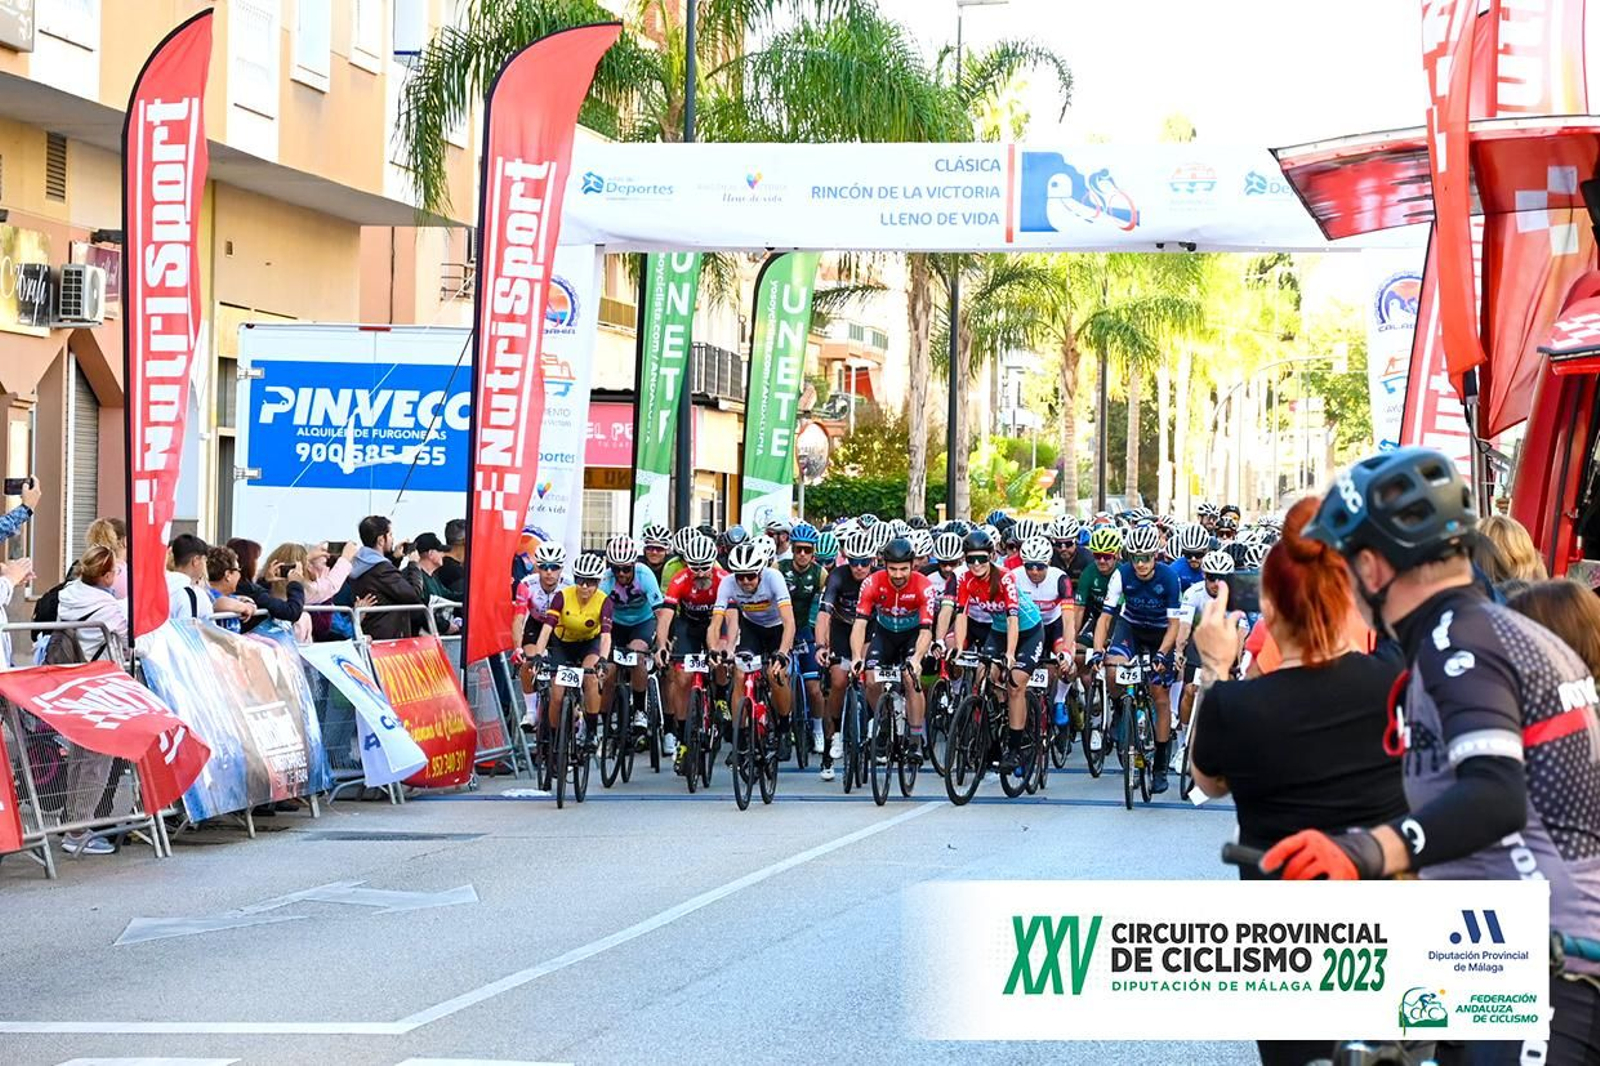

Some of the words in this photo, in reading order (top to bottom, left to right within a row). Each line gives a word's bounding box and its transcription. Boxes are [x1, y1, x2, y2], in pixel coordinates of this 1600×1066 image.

[934, 156, 1001, 172] CLÁSICA
[606, 181, 674, 197] Deportes
[811, 182, 873, 199] RINCÓN
[878, 186, 899, 199] DE
[902, 186, 923, 199] LA
[927, 185, 1001, 199] VICTORIA
[880, 212, 933, 226] LLENO
[936, 212, 957, 226] DE
[962, 212, 1000, 226] VIDA
[354, 429, 369, 438] DE
[372, 429, 447, 440] FURGONEAS
[295, 442, 343, 463] 900
[1119, 671, 1138, 680] 475
